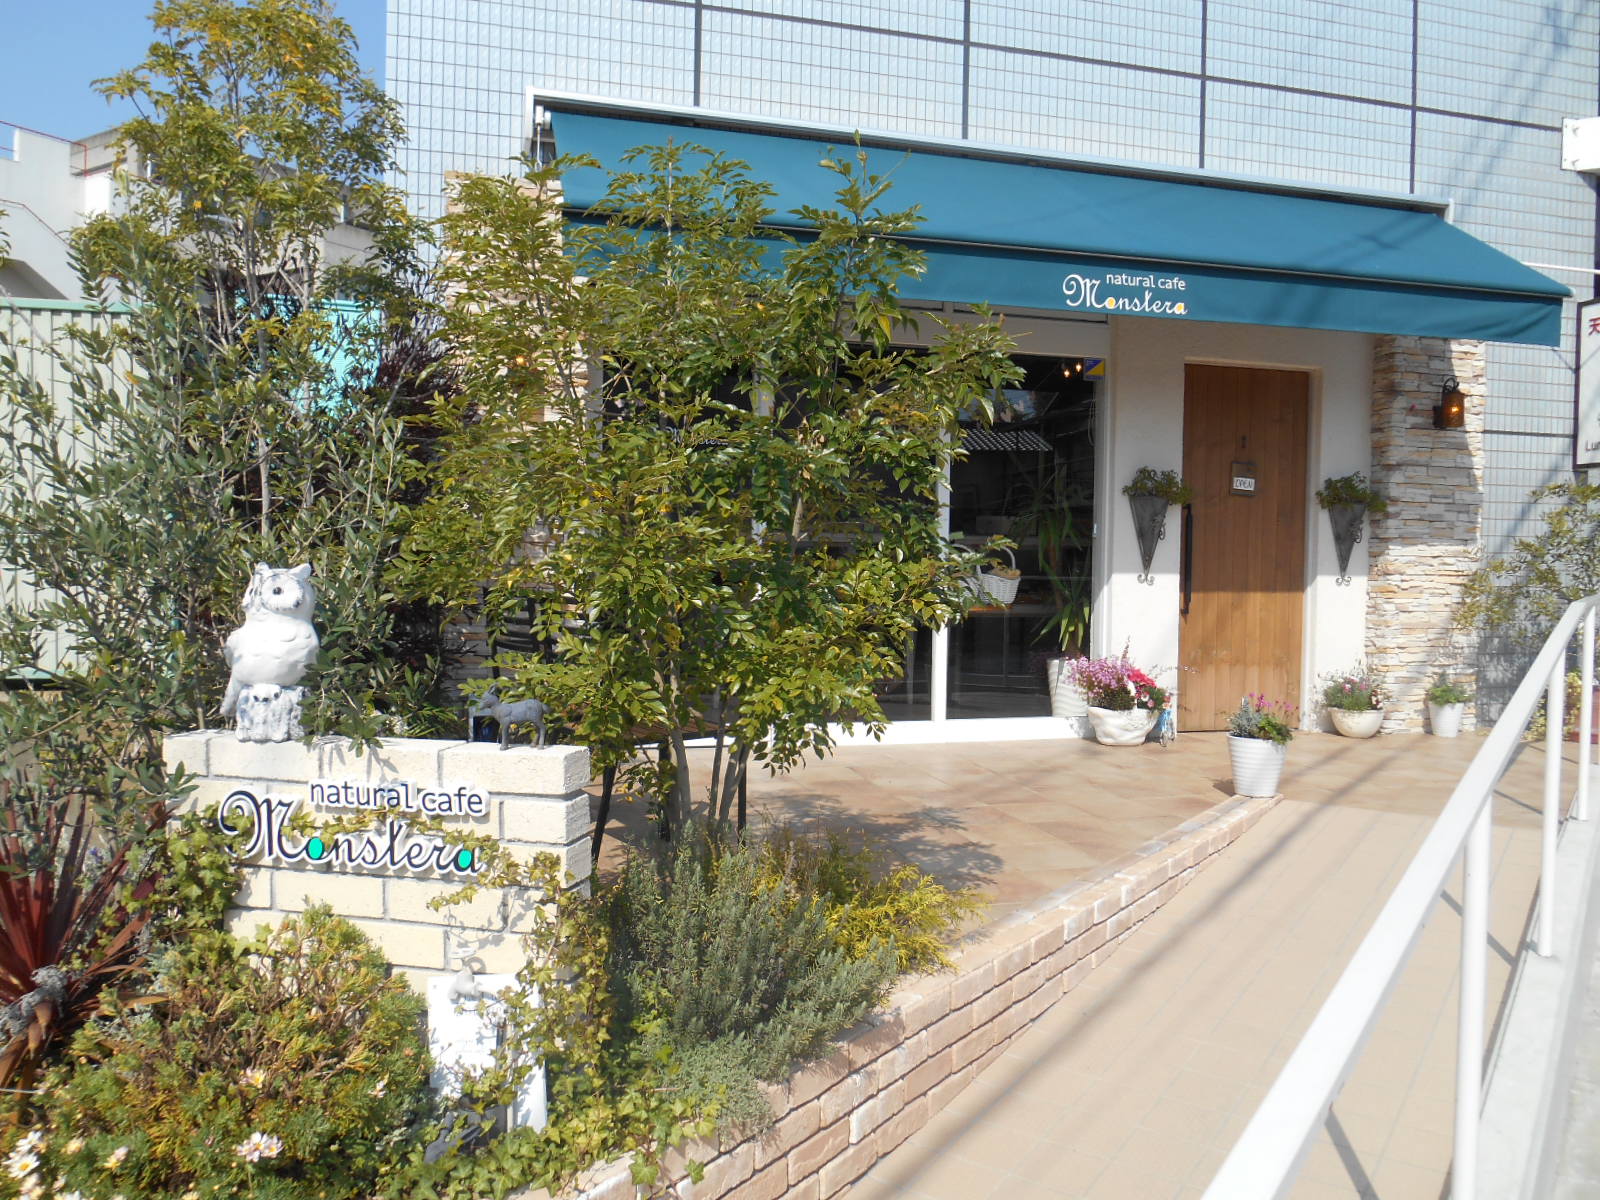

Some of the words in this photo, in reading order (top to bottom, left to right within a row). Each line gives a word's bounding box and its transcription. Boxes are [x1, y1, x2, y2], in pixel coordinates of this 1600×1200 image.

[1062, 274, 1188, 315] Monstera
[1106, 273, 1155, 288] natural
[1158, 277, 1186, 290] cafe
[310, 780, 414, 809] natural
[421, 785, 483, 814] cafe
[219, 789, 484, 874] Monstera
